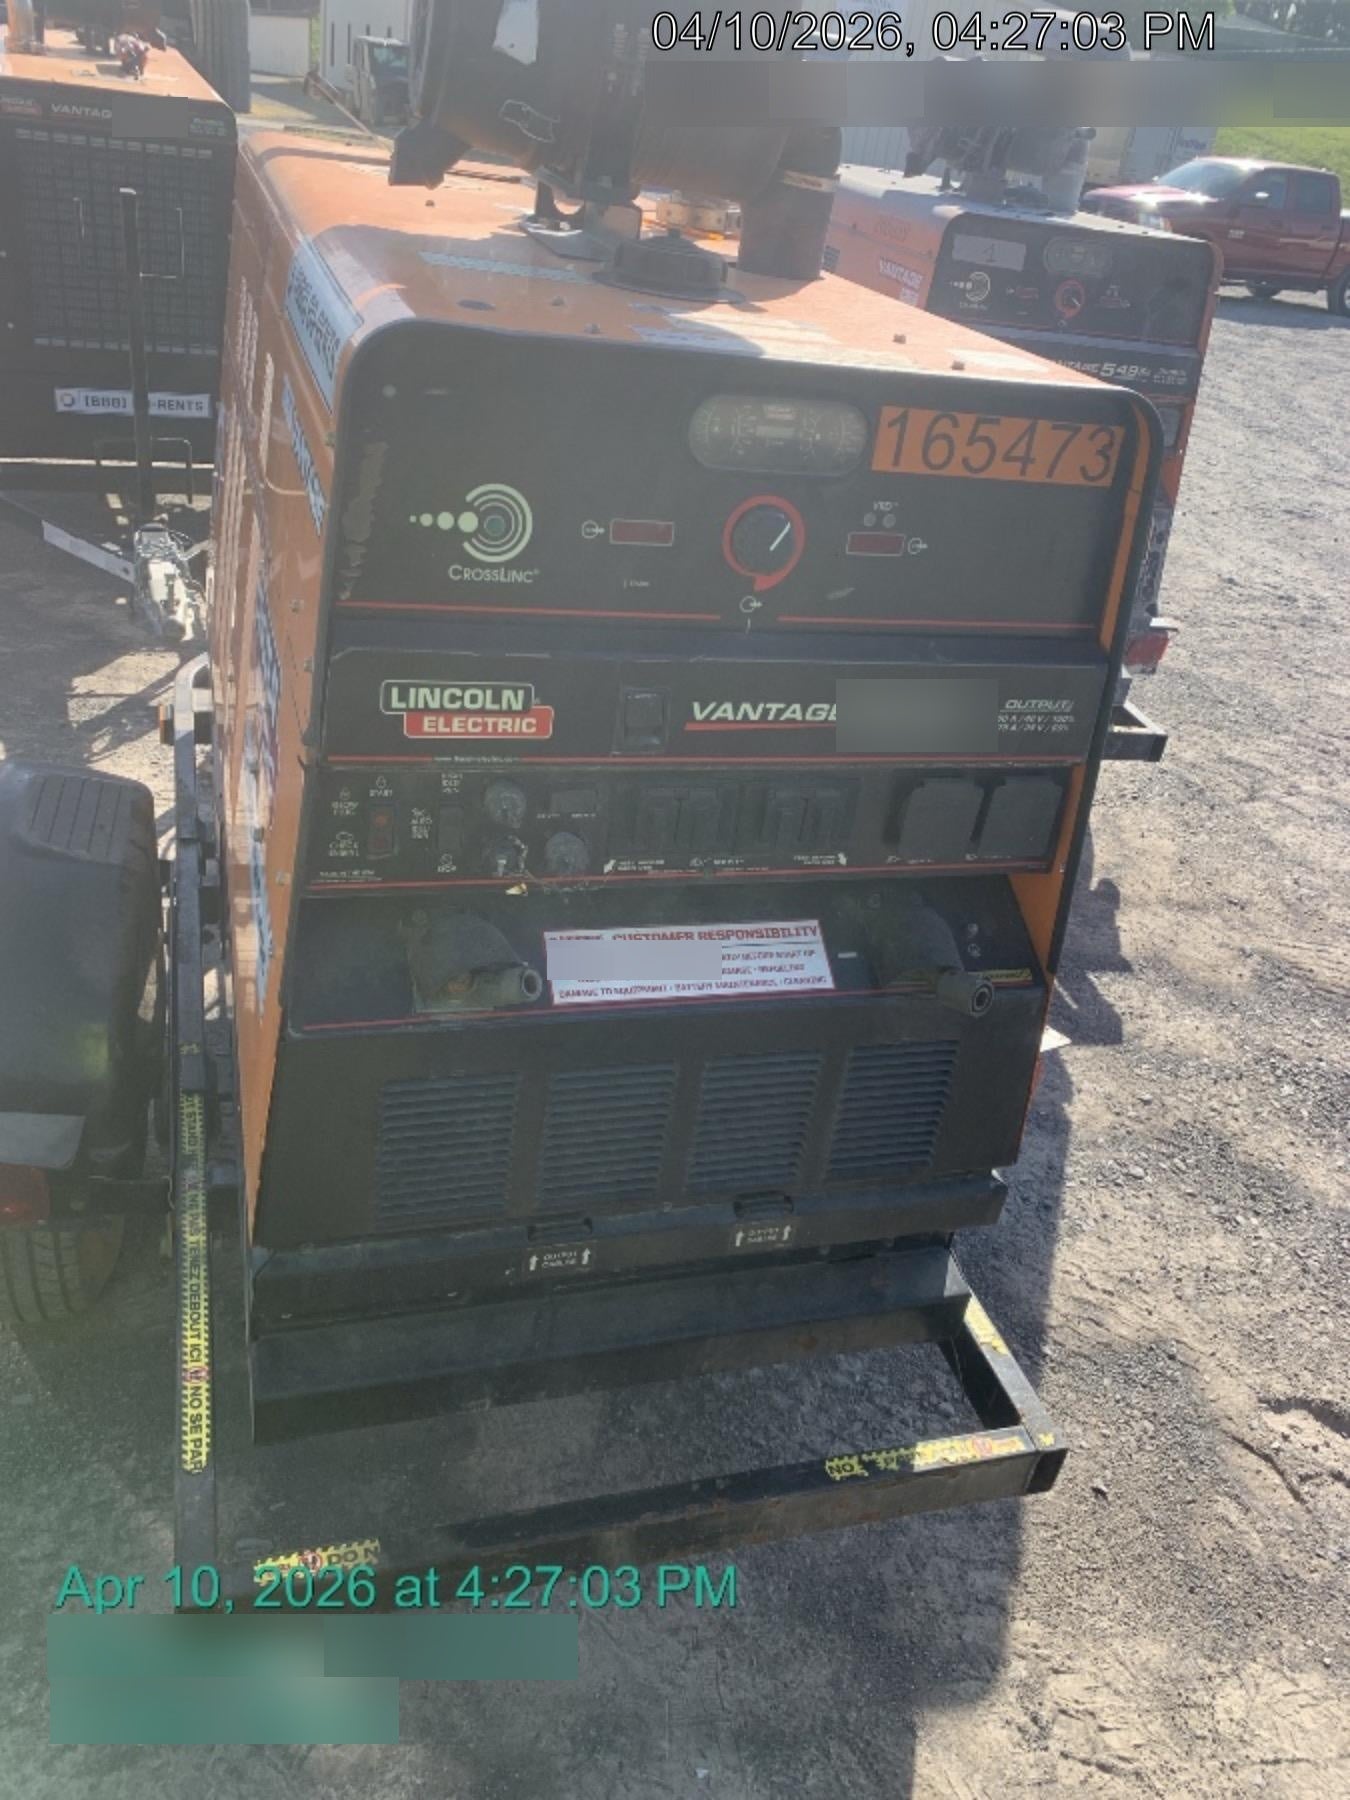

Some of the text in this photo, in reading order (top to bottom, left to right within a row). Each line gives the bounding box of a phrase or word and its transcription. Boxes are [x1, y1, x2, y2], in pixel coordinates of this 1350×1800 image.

[50, 103, 113, 119] VANTAG
[886, 409, 1114, 483] 165473
[390, 686, 525, 712] LINCOLN
[422, 715, 538, 734] ELECTRIC
[697, 924, 818, 941] RESPONSIBILITY
[189, 1283, 201, 1341] DEBOUT
[189, 1343, 201, 1363] ICI
[189, 1386, 203, 1410] NO
[189, 1412, 203, 1435] SE
[327, 1549, 358, 1566] DO
